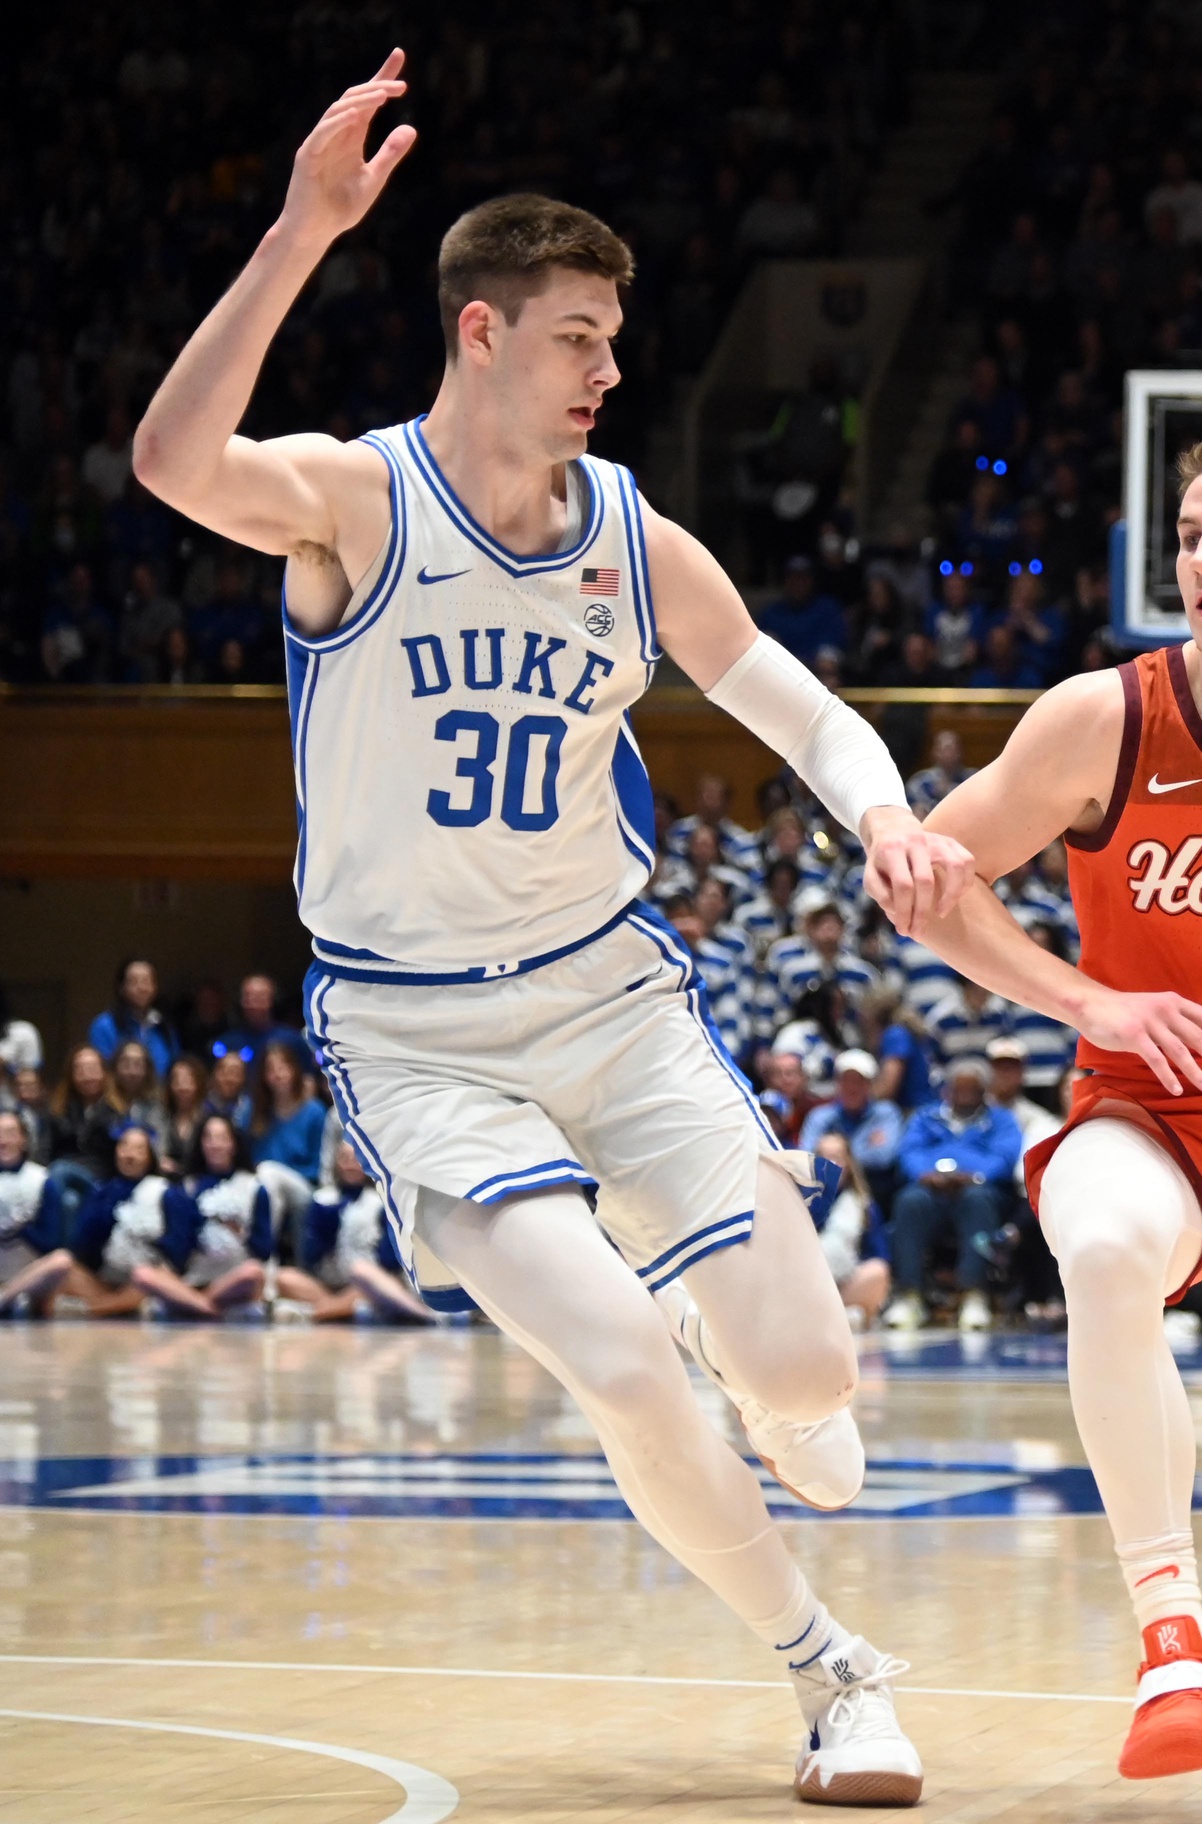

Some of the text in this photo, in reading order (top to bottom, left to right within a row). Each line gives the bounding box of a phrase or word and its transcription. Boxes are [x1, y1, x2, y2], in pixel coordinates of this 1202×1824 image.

[588, 614, 613, 625] ACC
[400, 628, 615, 715] DUKE
[426, 709, 568, 831] 30
